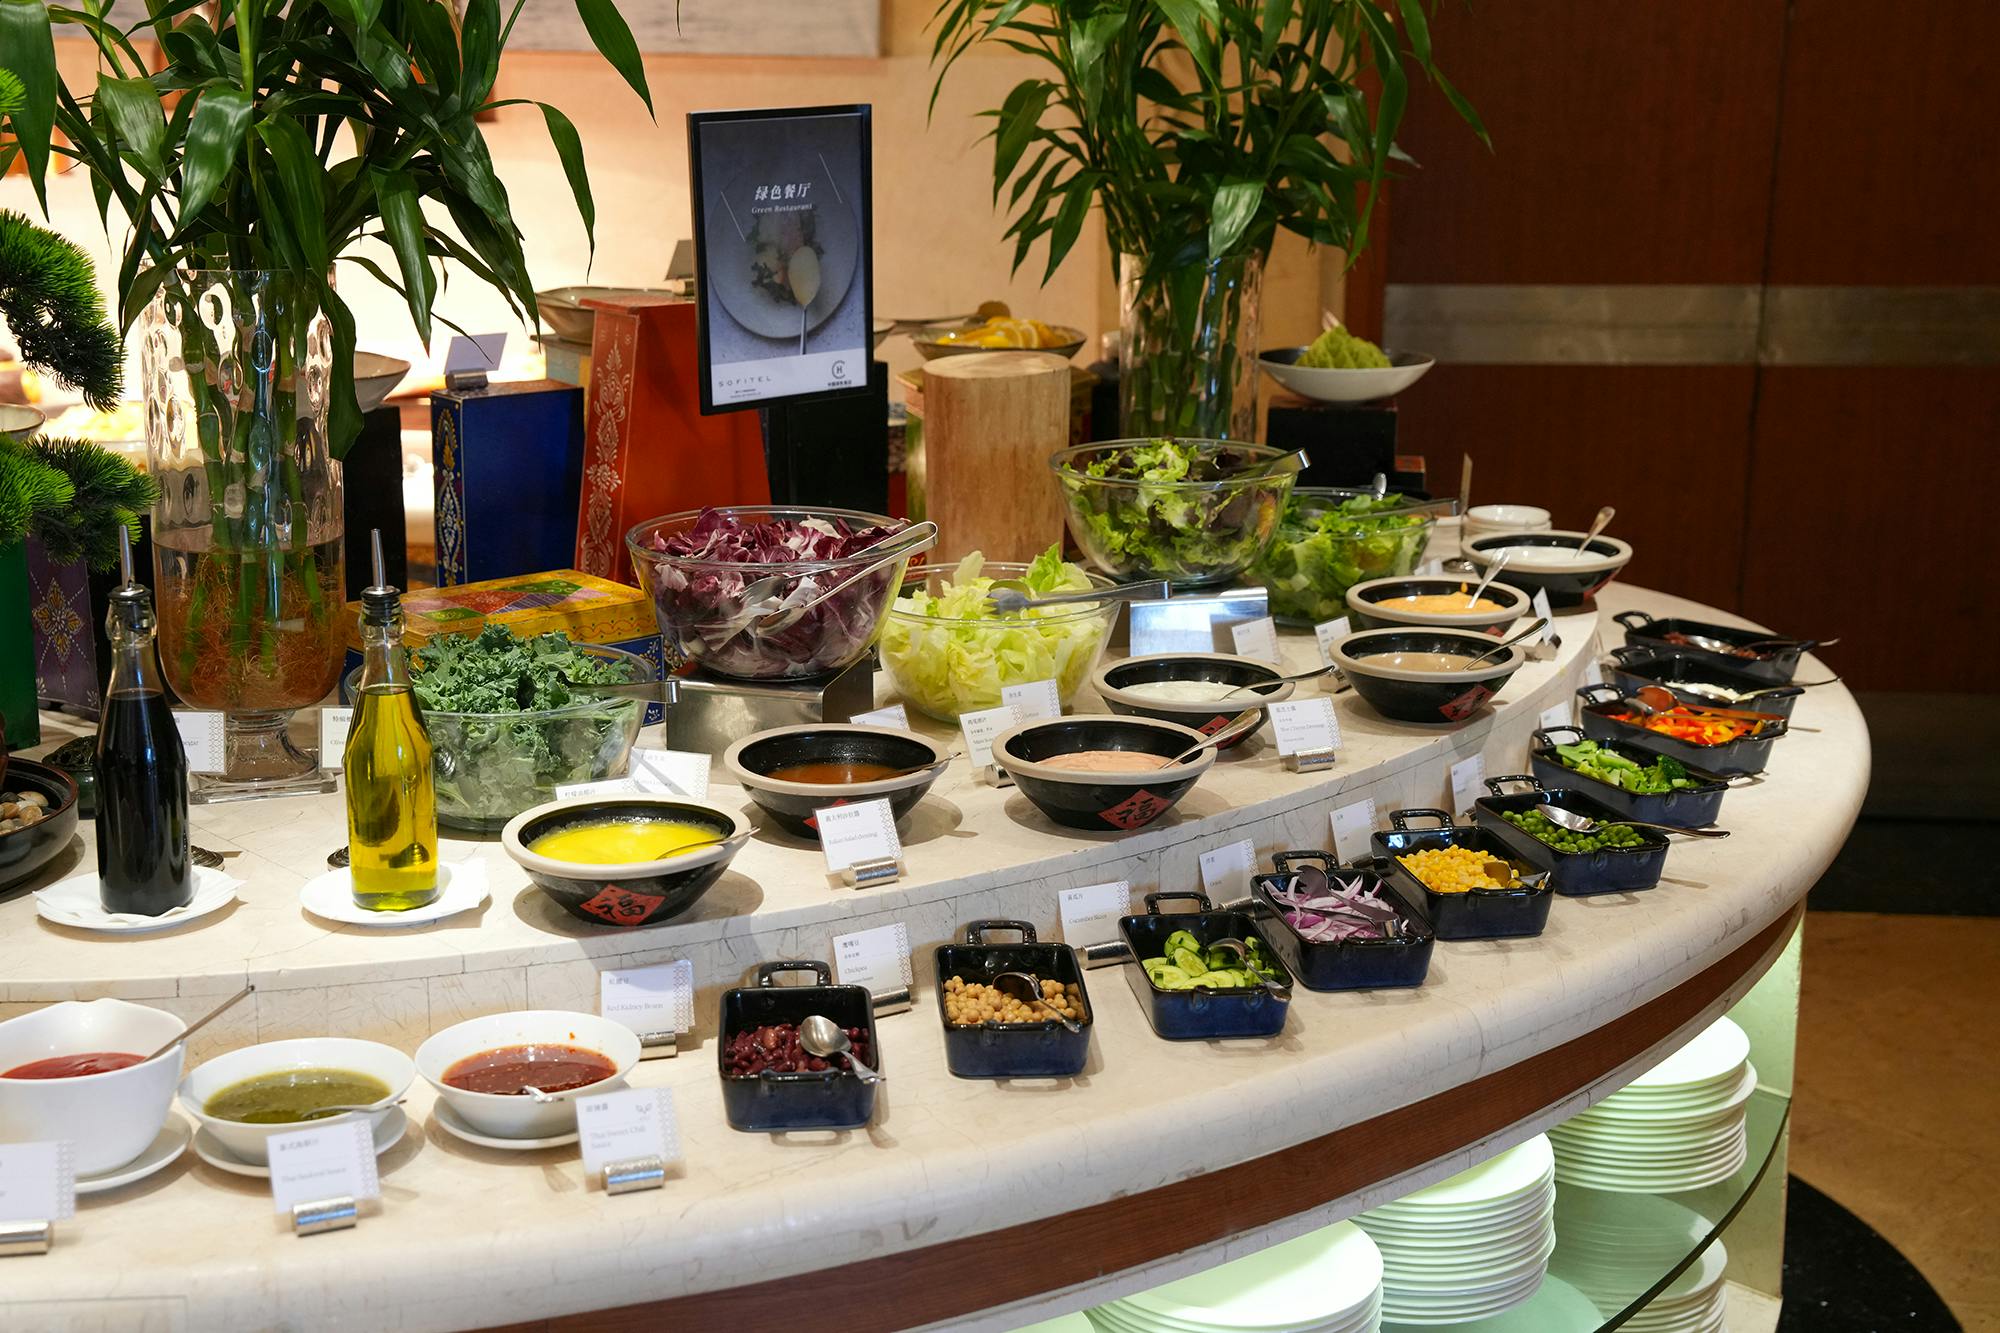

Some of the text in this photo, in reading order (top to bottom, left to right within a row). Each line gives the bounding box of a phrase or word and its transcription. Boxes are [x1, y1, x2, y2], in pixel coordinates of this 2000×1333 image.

[755, 183, 811, 200] 绿色餐厅
[751, 203, 813, 214] Green Restaurant
[718, 376, 772, 388] SOFITEL
